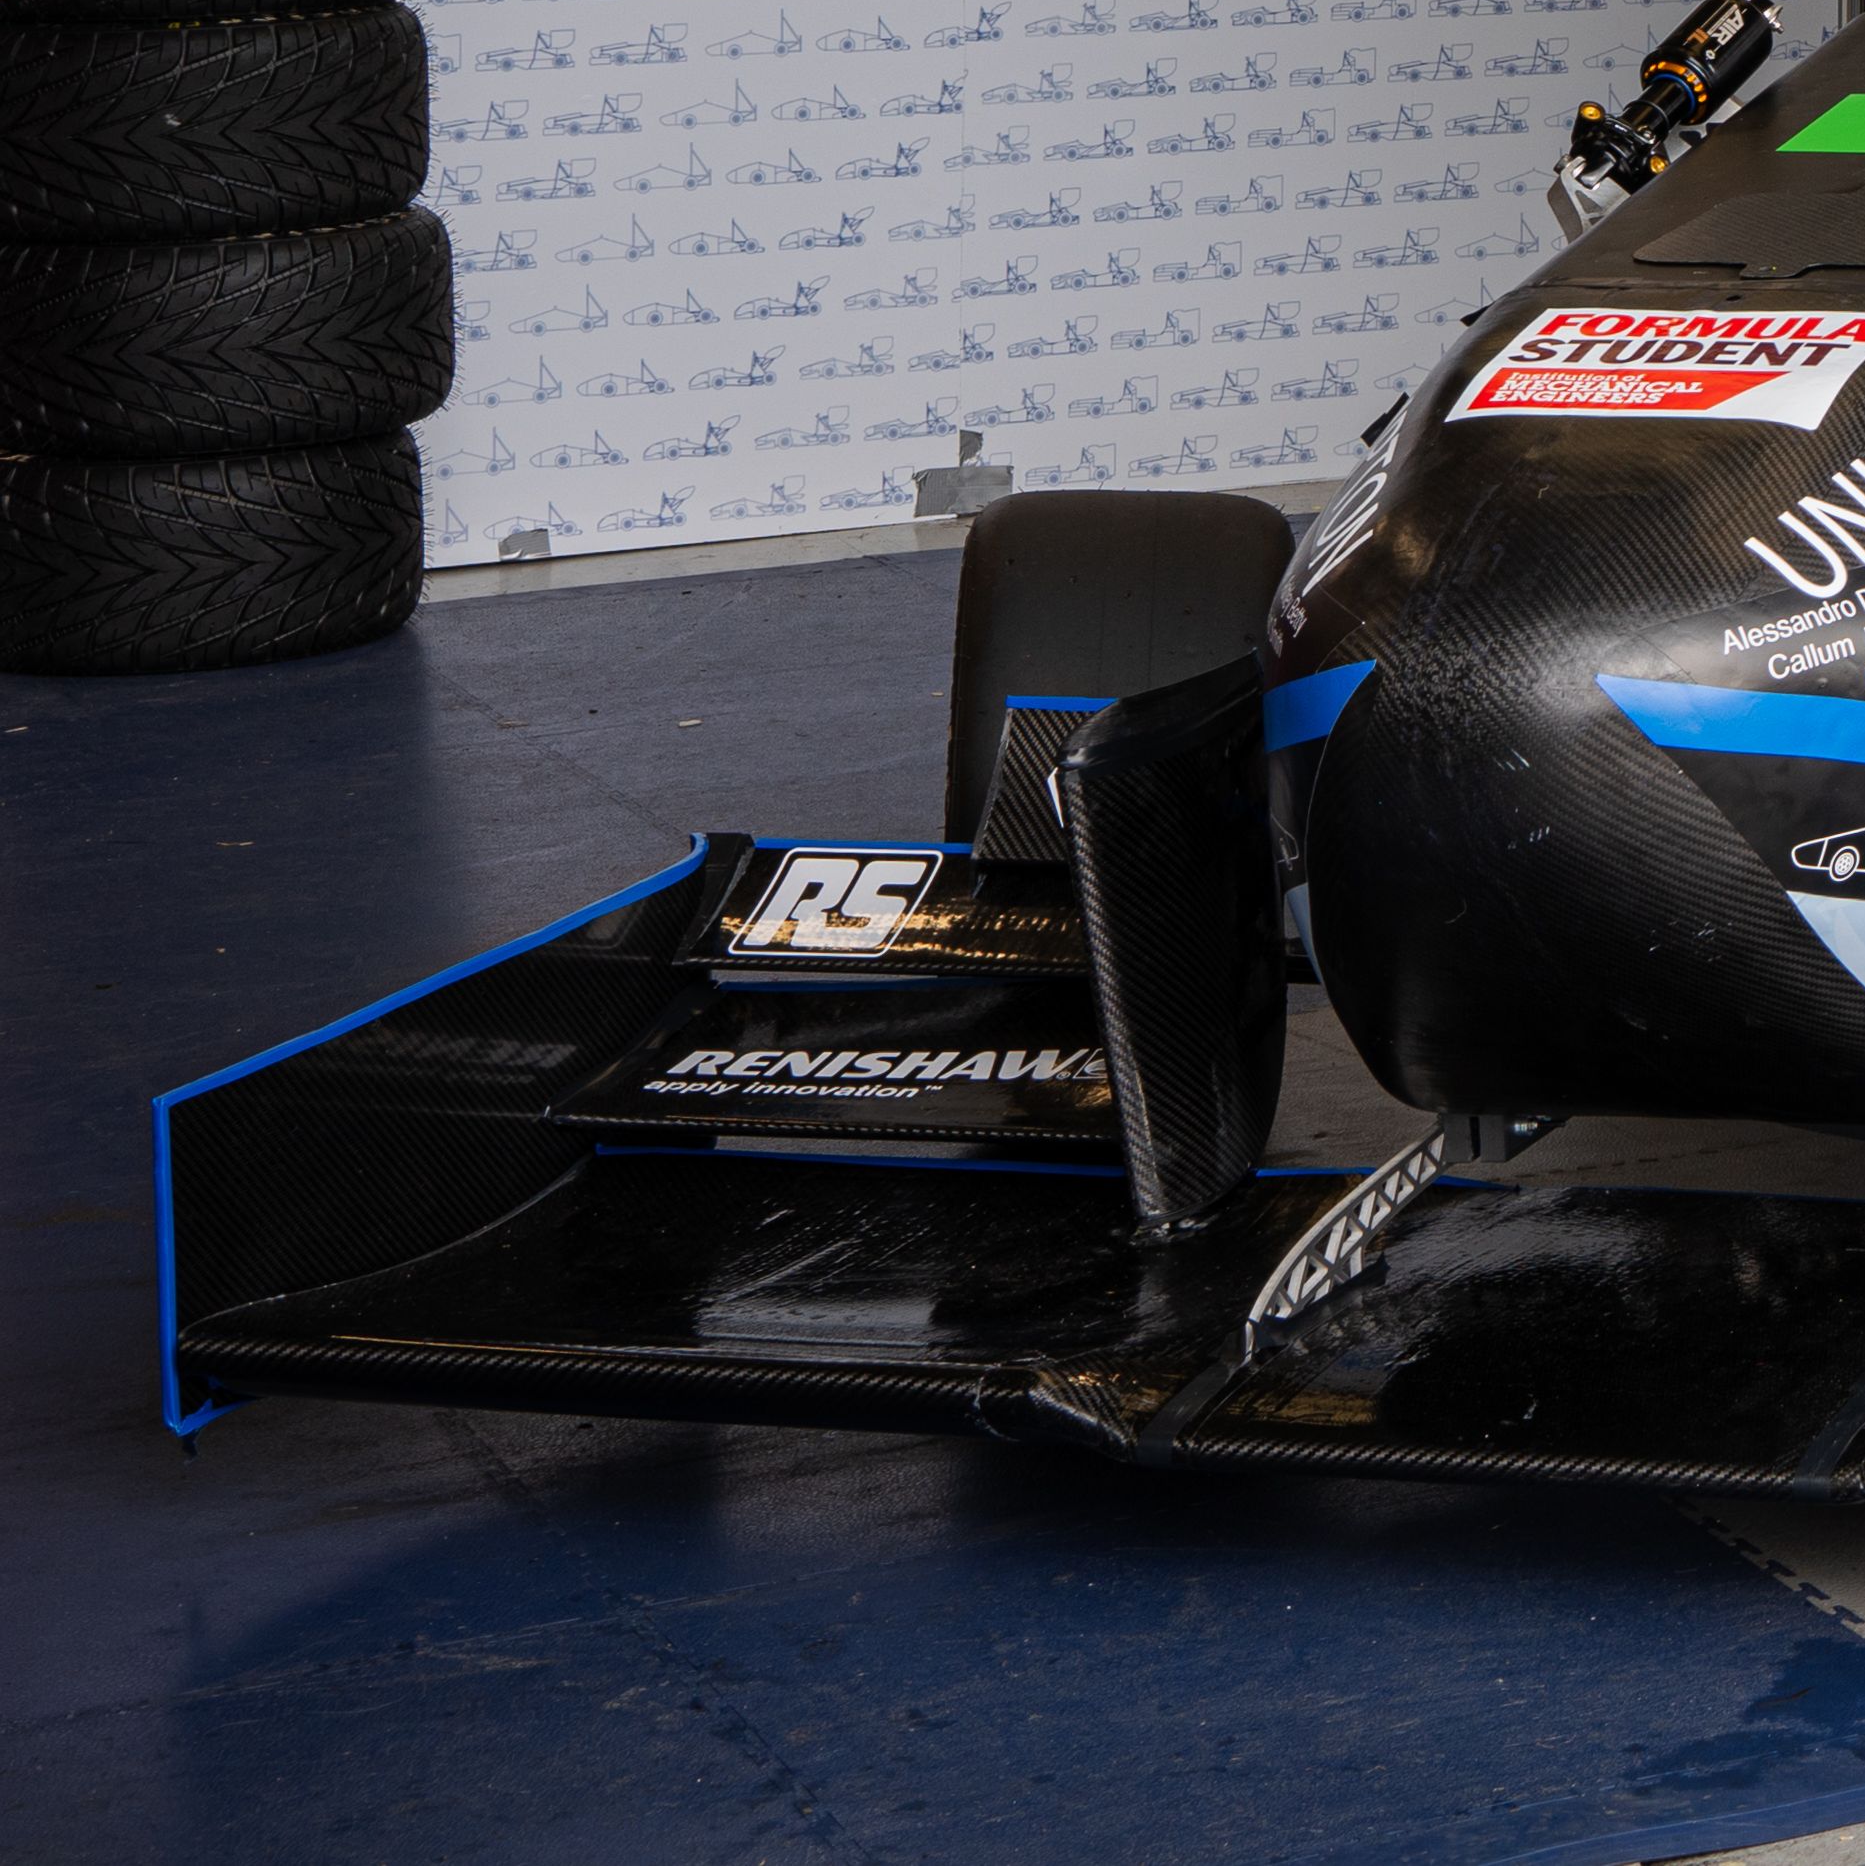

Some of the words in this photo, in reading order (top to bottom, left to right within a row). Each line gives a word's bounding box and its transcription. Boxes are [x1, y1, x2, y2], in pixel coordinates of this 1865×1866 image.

[1508, 338, 1851, 367] STUDENT
[1500, 380, 1704, 393] MECHANICAL
[1508, 372, 1618, 382] Institution
[1620, 374, 1647, 382] of
[1489, 391, 1665, 404] ENGINEERS
[1722, 597, 1857, 655] Alessandro
[1768, 636, 1856, 680] Callum
[743, 858, 928, 949] RS
[644, 1078, 740, 1095] apply
